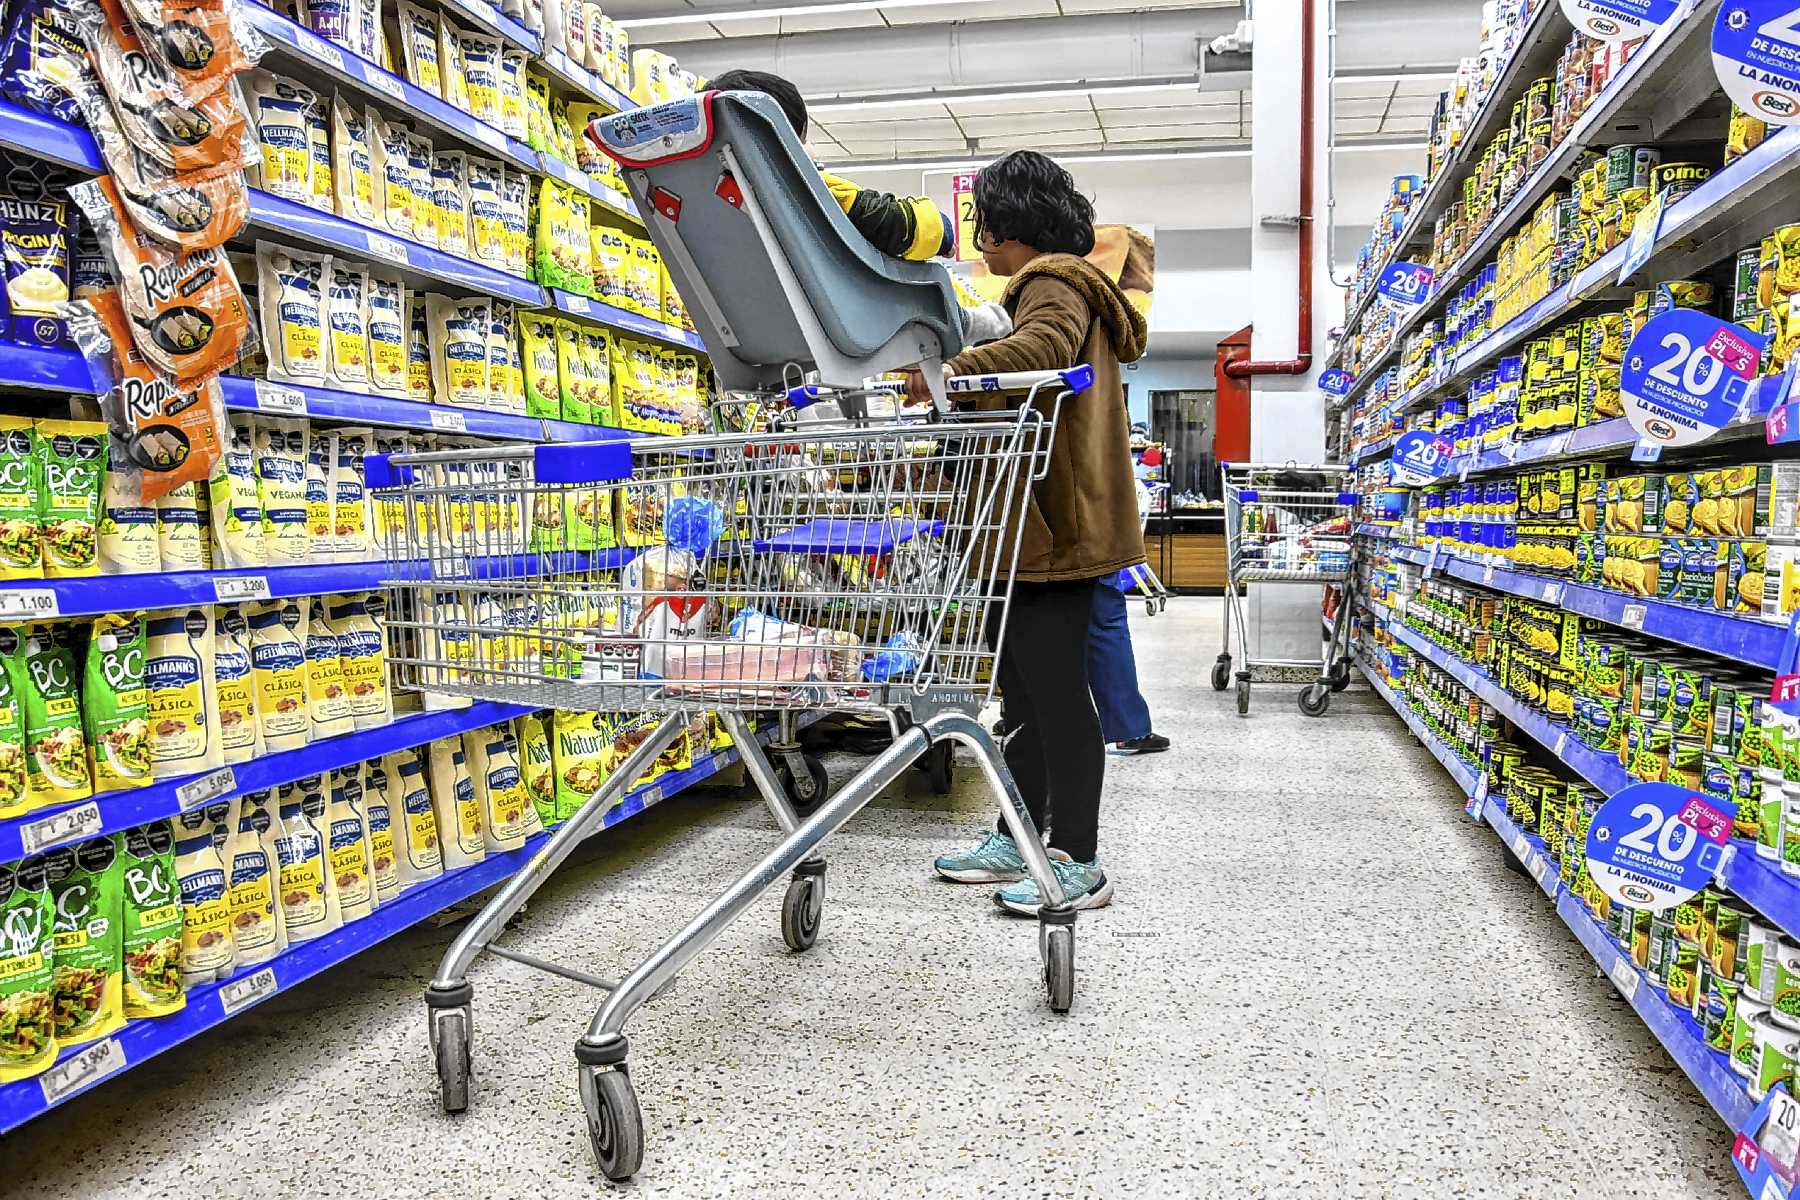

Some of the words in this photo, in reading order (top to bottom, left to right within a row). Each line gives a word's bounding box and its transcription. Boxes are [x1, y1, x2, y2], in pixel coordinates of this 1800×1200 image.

[1592, 6, 1641, 27] ANONIMA
[1594, 20, 1614, 32] Best
[43, 28, 85, 54] ORIGIN
[1751, 37, 1769, 52] DE
[1739, 65, 1757, 80] LA
[1761, 96, 1792, 113] Best
[1717, 331, 1754, 360] Exclusivo
[1647, 332, 1725, 396] 20
[1657, 382, 1709, 409] DESCUENTO
[1637, 399, 1648, 410] LA
[1650, 405, 1699, 431] ANONIMA
[1406, 439, 1440, 465] 20
[47, 464, 90, 490] BC
[243, 579, 265, 592] 3.200
[19, 596, 52, 610] 1.100
[30, 658, 70, 693] BC
[103, 649, 144, 688] BC
[209, 773, 233, 791] 5.050
[66, 809, 98, 830] 2.050
[1691, 801, 1727, 827] Exclusivo
[1619, 803, 1698, 861] 20
[1629, 849, 1684, 875] DESCUENTO
[125, 865, 170, 905] BC
[1607, 866, 1621, 877] LA
[1624, 871, 1676, 895] ANONIMA
